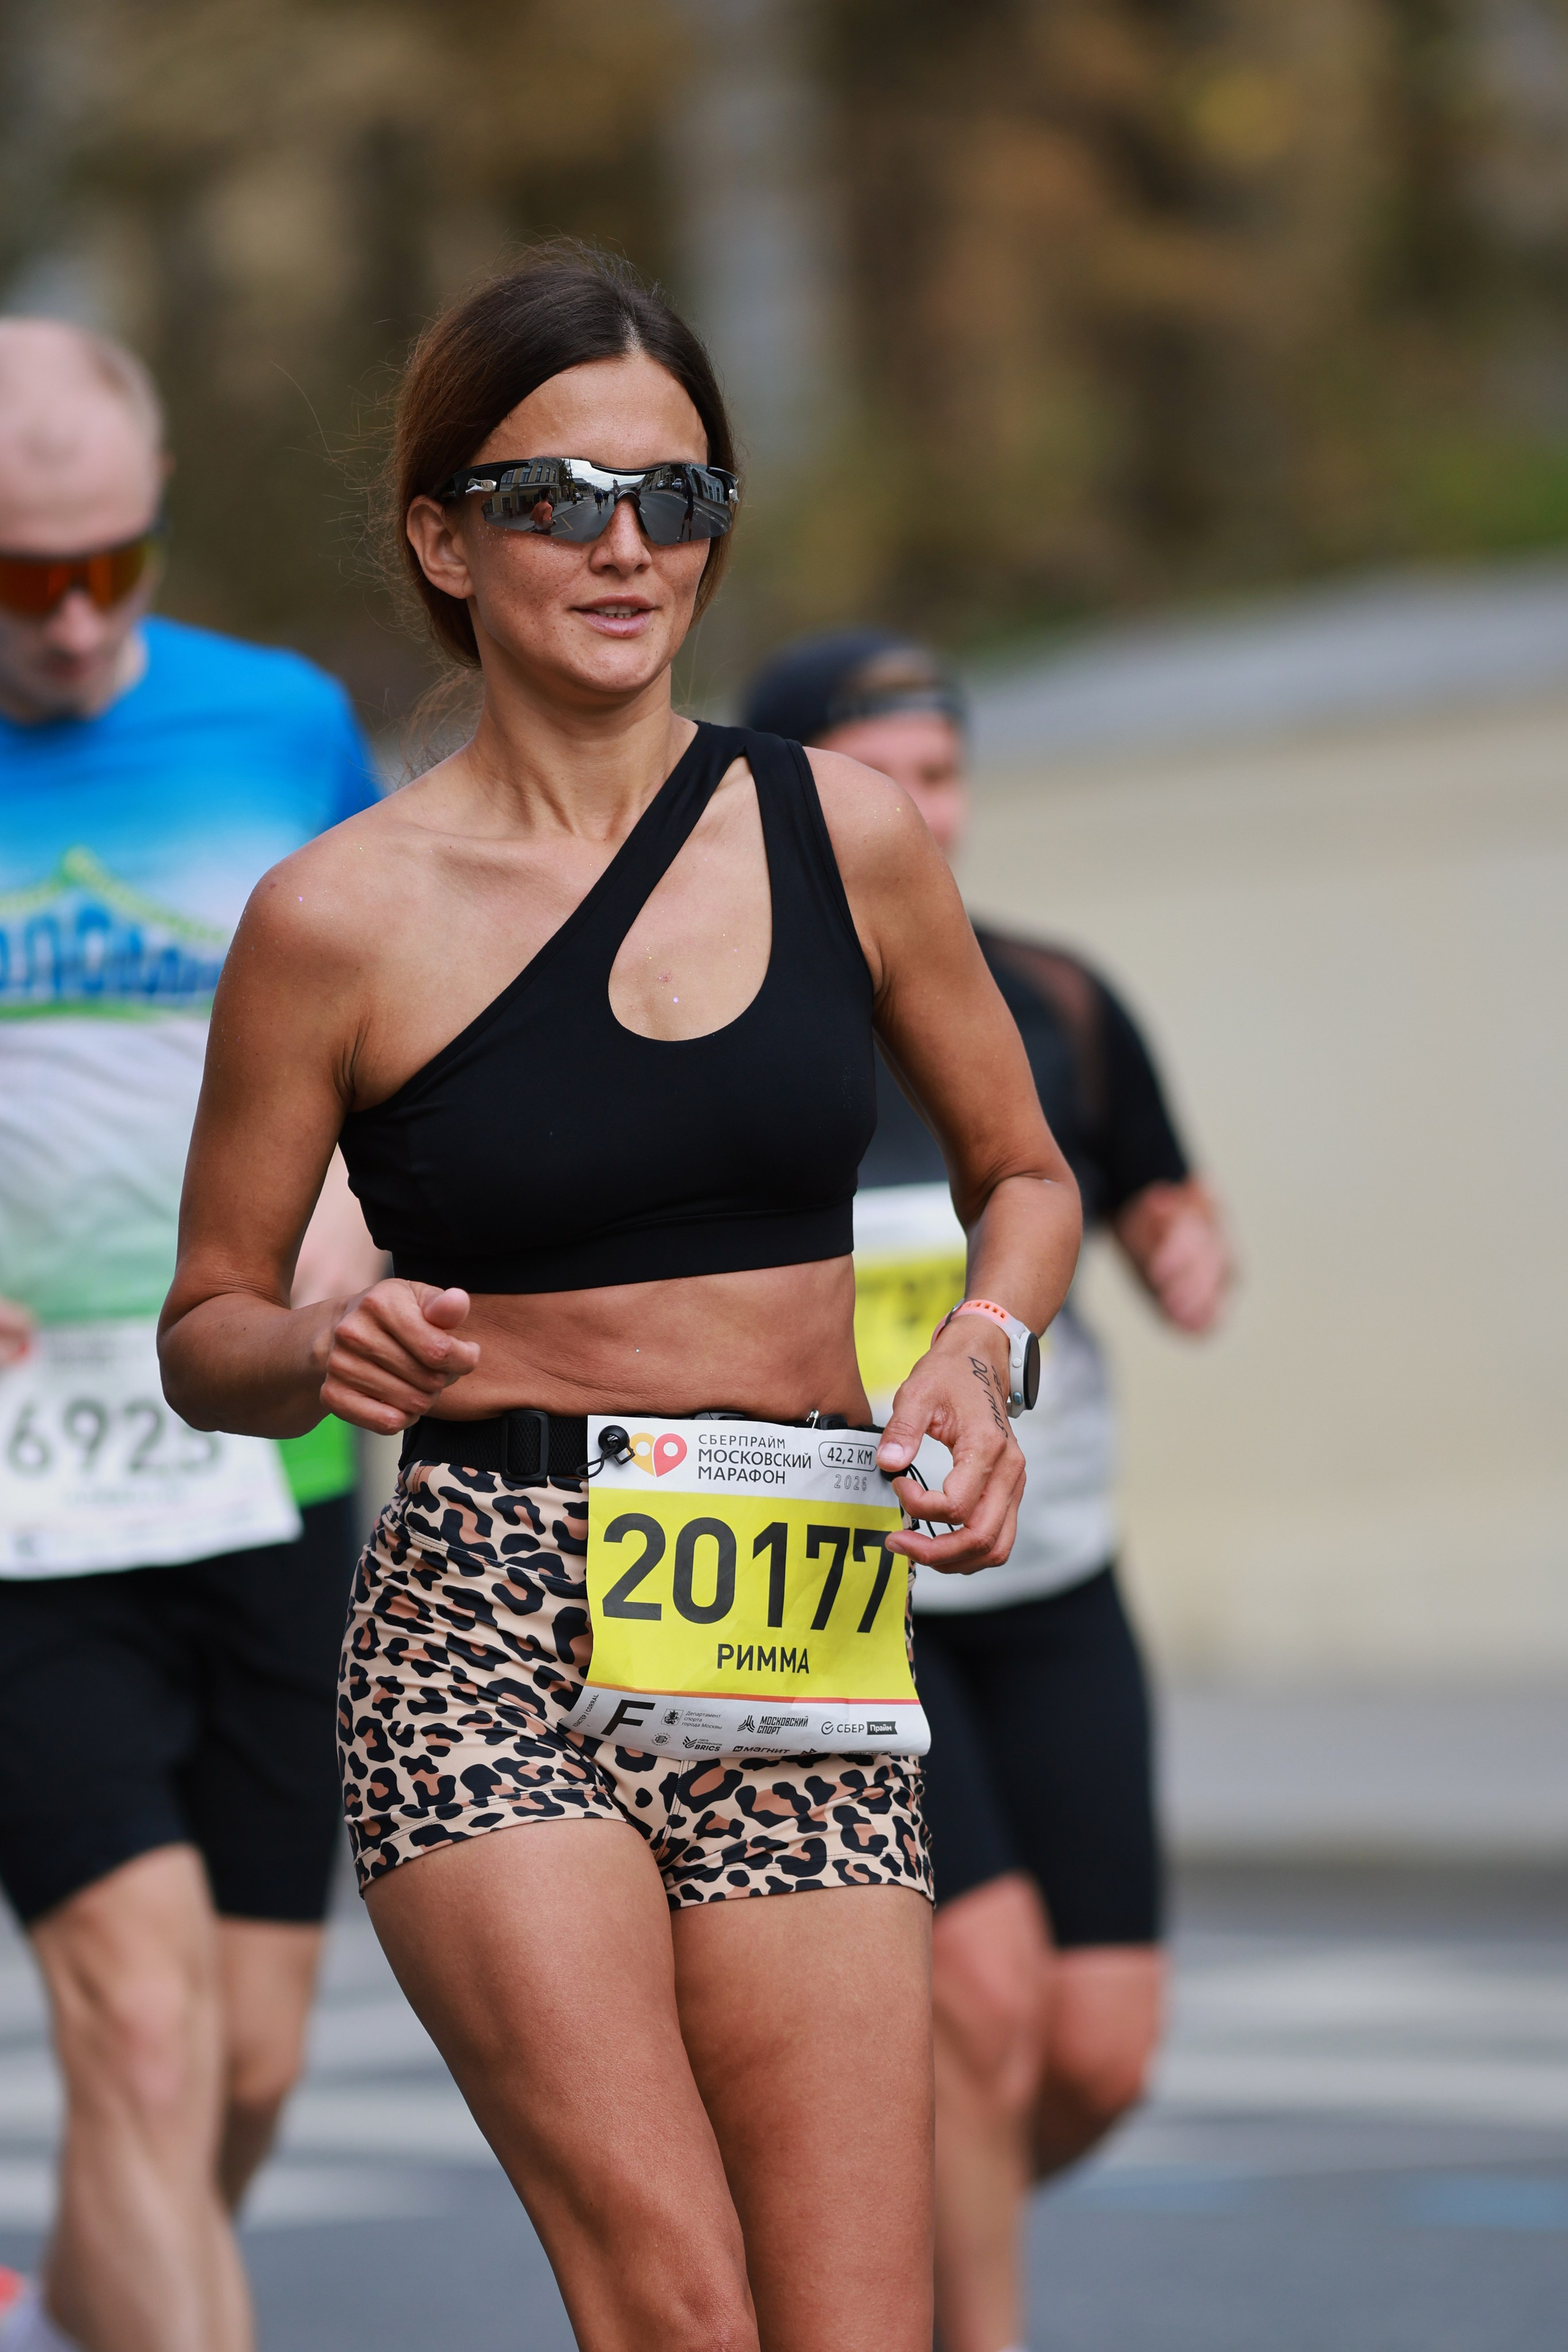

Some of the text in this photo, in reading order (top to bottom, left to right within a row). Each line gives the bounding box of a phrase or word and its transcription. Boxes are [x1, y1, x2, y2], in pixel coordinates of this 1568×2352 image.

[967, 1356, 1008, 1438] DO THIS
[698, 1434, 785, 1449] СБЕРПРАЙМ
[698, 1449, 812, 1469] МОСКОВСКИЙ
[827, 1447, 873, 1466] 42,2 КМ
[698, 1466, 785, 1484] МАРАФОН
[834, 1474, 867, 1491] 2026
[601, 1512, 894, 1634] 20177
[717, 1643, 810, 1675] РИММА
[586, 1694, 599, 1713] CORRAL
[600, 1699, 656, 1736] F
[760, 1716, 809, 1727] МОСКОВСКИЙ
[757, 1725, 782, 1735] СПОРТ
[837, 1724, 892, 1733] СБЕР Прайм
